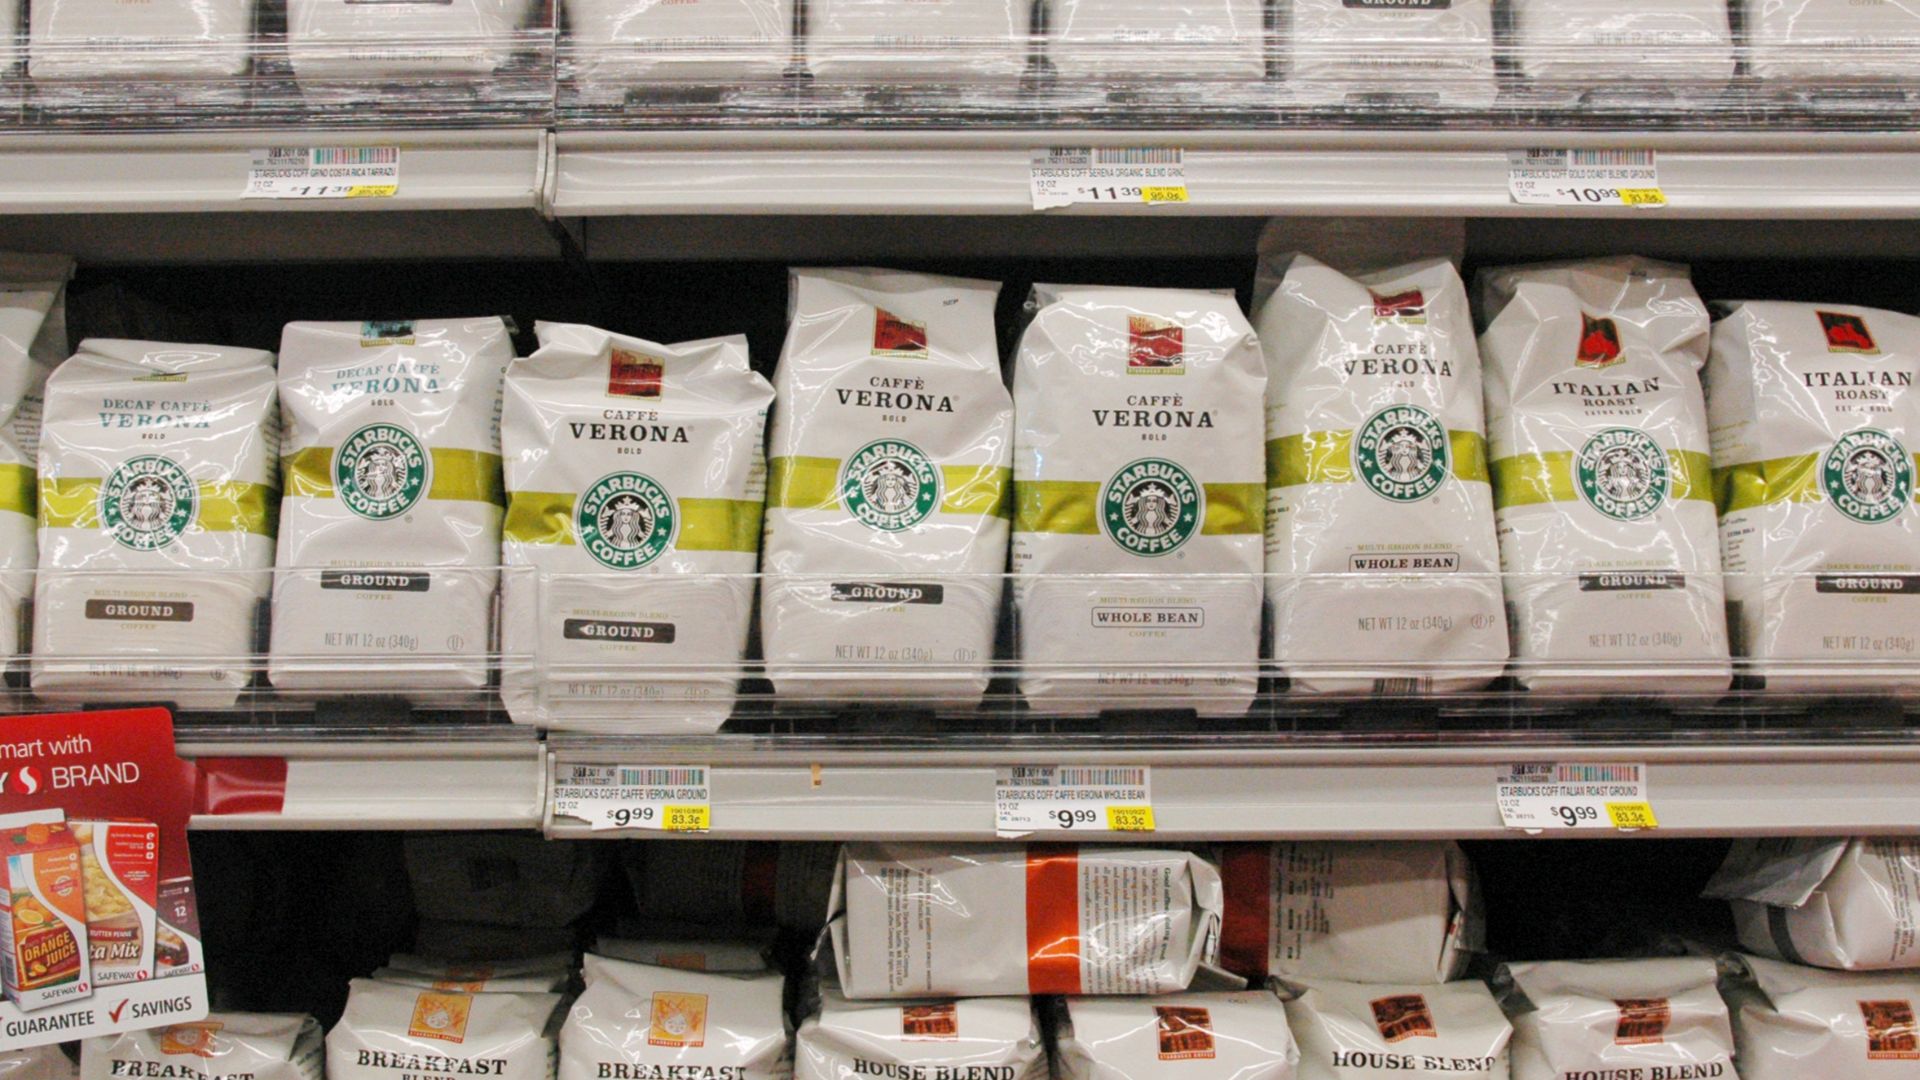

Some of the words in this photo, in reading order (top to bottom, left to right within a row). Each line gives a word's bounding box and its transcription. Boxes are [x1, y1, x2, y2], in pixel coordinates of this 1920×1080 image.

[254, 169, 291, 177] STARBUCKS
[293, 169, 309, 177] COFF
[351, 168, 365, 176] RICA
[1032, 169, 1069, 177] STARBUCKS
[1071, 169, 1087, 177] COFF
[1089, 169, 1114, 177] SERENA
[1115, 169, 1143, 177] ORGANIC
[1145, 169, 1165, 177] BLEND
[1514, 169, 1550, 179] STARBUCKS
[1552, 169, 1567, 179] COFF
[1569, 170, 1585, 179] GOLD
[1587, 170, 1607, 179] COAST
[1609, 170, 1628, 179] BLEND
[1630, 170, 1655, 179] GROUND
[336, 365, 382, 379] DECAF
[388, 361, 440, 375] CAFÈ
[1344, 359, 1452, 377] VERONA
[870, 376, 924, 390] CAFFÈ
[1553, 377, 1661, 396] ITALIAN
[1804, 372, 1912, 387] ITALIAN
[836, 388, 953, 412] VERONA
[1127, 393, 1183, 406] CAFFÈ
[1583, 398, 1636, 407] ROAST
[1835, 390, 1888, 401] ROAST
[103, 399, 156, 410] DECAF
[161, 399, 212, 412] CAFFÈ
[603, 408, 658, 421] CAFFÈ
[1092, 409, 1213, 428] VERONA
[569, 423, 689, 444] VERONA
[1361, 408, 1444, 451] STARBUCKS
[342, 429, 422, 469] STARBUCKS
[1581, 431, 1665, 472] STARBUCKS
[1827, 435, 1908, 474] STARBUCKS
[848, 444, 934, 485] STARBUCKS
[108, 461, 192, 499] STARBUCKS
[1107, 464, 1196, 504] STARBUCKS
[1371, 473, 1437, 499] COFFEE
[349, 492, 410, 516] COFFEE
[584, 475, 670, 519] STARBUCKS
[1838, 493, 1903, 520] COFFEE
[1118, 526, 1184, 552] COFFEE
[591, 539, 657, 566] COFFEE
[1355, 558, 1409, 570] WHOLE
[1414, 557, 1453, 568] BEAN
[340, 575, 410, 587] GROUND
[1600, 574, 1667, 587] GROUND
[1836, 578, 1904, 590] GROUND
[851, 587, 922, 598] GROUND
[105, 604, 174, 617] GROUND
[1097, 612, 1152, 623] WHOLE
[1157, 612, 1198, 624] BEAN
[583, 624, 654, 638] GROUND
[1358, 618, 1376, 631] NET
[1379, 617, 1393, 630] WT
[1397, 617, 1408, 630] 12
[325, 633, 342, 647] NET
[344, 633, 360, 647] WT
[363, 633, 373, 647] 12
[836, 645, 854, 658] NET
[858, 646, 871, 659] WT
[874, 647, 885, 659] 12
[49, 734, 91, 756] with
[52, 762, 140, 789] BRAND
[555, 788, 599, 799] STARBUCKS
[601, 789, 619, 799] COFF
[621, 789, 644, 799] CAFFE
[646, 789, 674, 799] VERONA
[676, 789, 707, 799] GROUND
[997, 790, 1035, 800] STARBUCKS
[1037, 790, 1053, 799] COFF
[1055, 790, 1075, 799] CAFFE
[1077, 790, 1103, 800] VERONA
[1104, 790, 1126, 799] WHOLE
[1128, 790, 1145, 799] BEAN
[1500, 787, 1540, 796] STARBUCKS
[1542, 787, 1558, 796] COFF
[1560, 787, 1585, 796] ITALIAN
[1586, 787, 1608, 796] ROAST
[1610, 787, 1638, 796] GROUND
[175, 906, 187, 917] 12
[24, 930, 71, 962] ORANGE
[47, 943, 77, 967] JUICE
[110, 941, 139, 959] Mix
[98, 971, 136, 981] SAFEWAY
[41, 985, 77, 1001] SAFEWAY
[6, 1010, 95, 1037] GUARANTEE
[132, 995, 192, 1018] SAVINGS
[357, 1049, 507, 1075] BREAKFAST
[853, 1058, 926, 1080] HOUSE
[935, 1066, 1014, 1080] BLEND
[1333, 1051, 1416, 1069] HOUSE
[597, 1062, 747, 1080] BREAKFAST
[1565, 1068, 1643, 1080] HOUSE
[1651, 1062, 1723, 1080] BLEND
